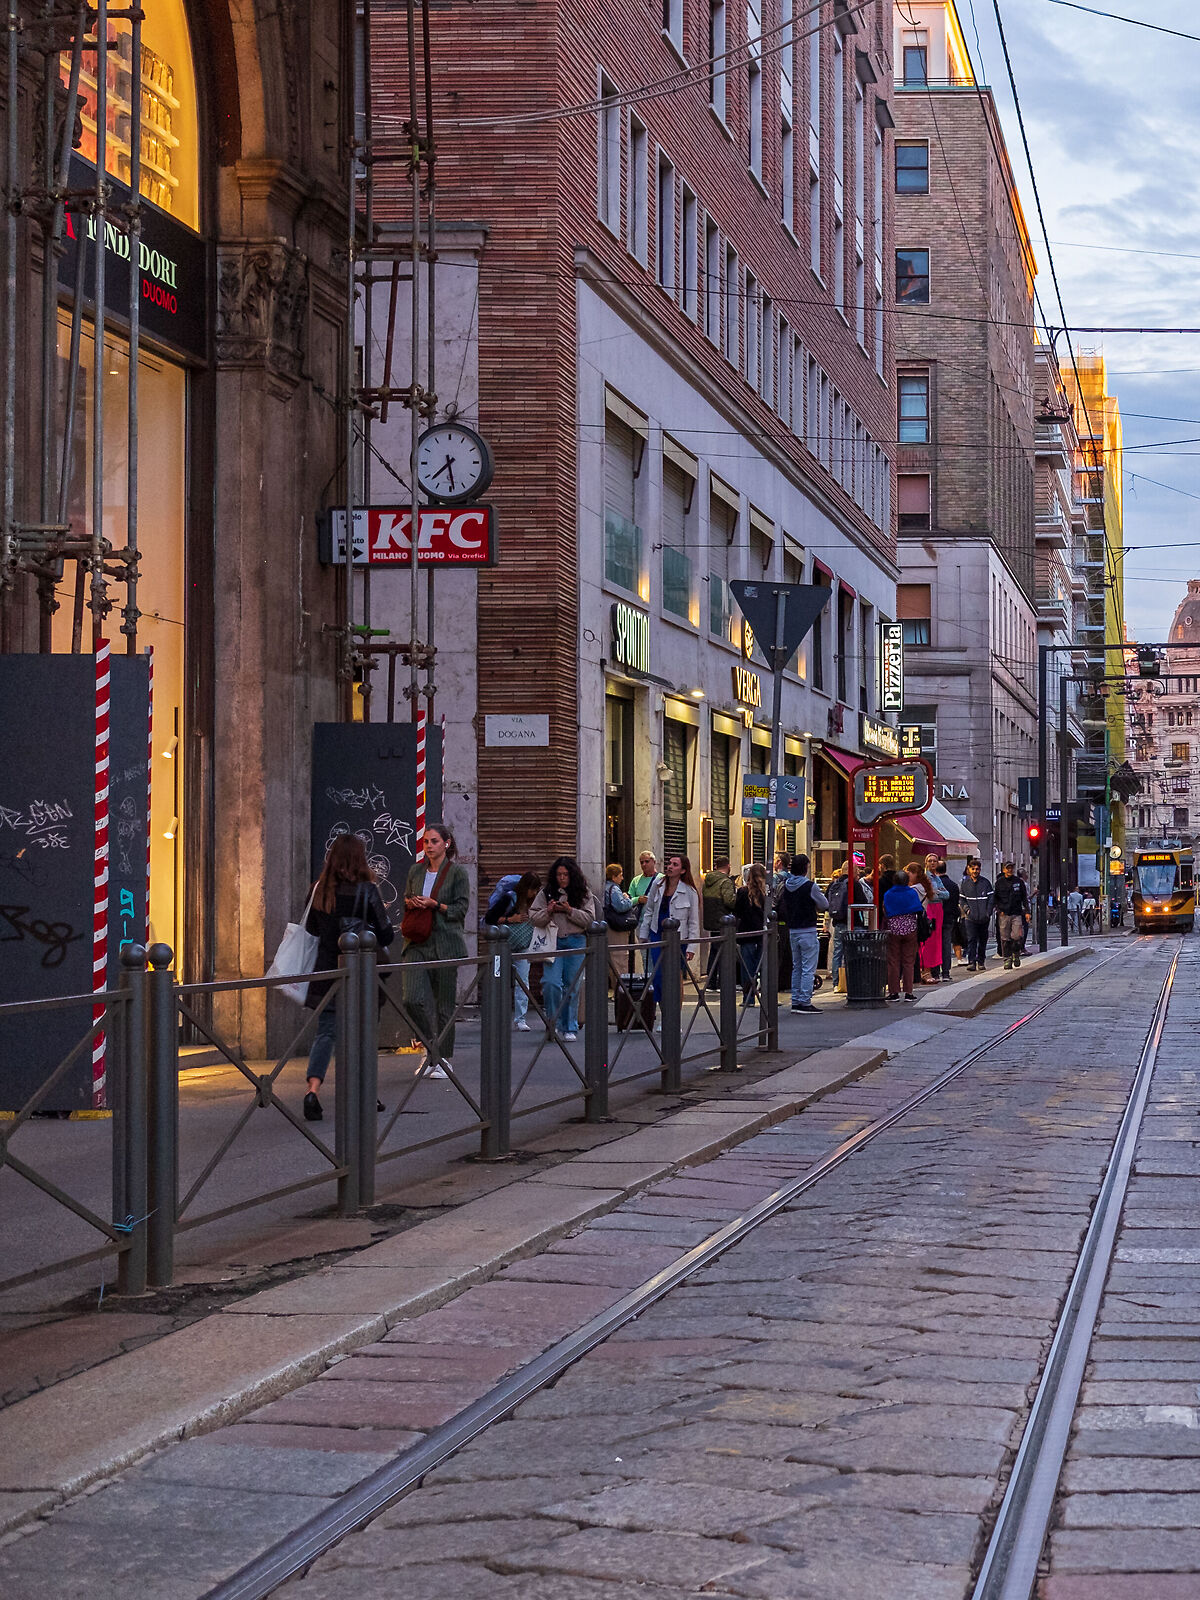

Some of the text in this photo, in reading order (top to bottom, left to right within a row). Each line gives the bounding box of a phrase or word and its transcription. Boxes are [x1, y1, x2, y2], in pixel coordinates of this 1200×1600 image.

[86, 213, 178, 289] NDDORI
[142, 279, 178, 314] DUOMO
[372, 512, 485, 550] KFC
[372, 552, 408, 560] MILANO
[413, 551, 445, 559] UOMO
[884, 626, 902, 708] Pizzeria
[735, 666, 762, 708] VERGA
[498, 730, 536, 739] DOGANA
